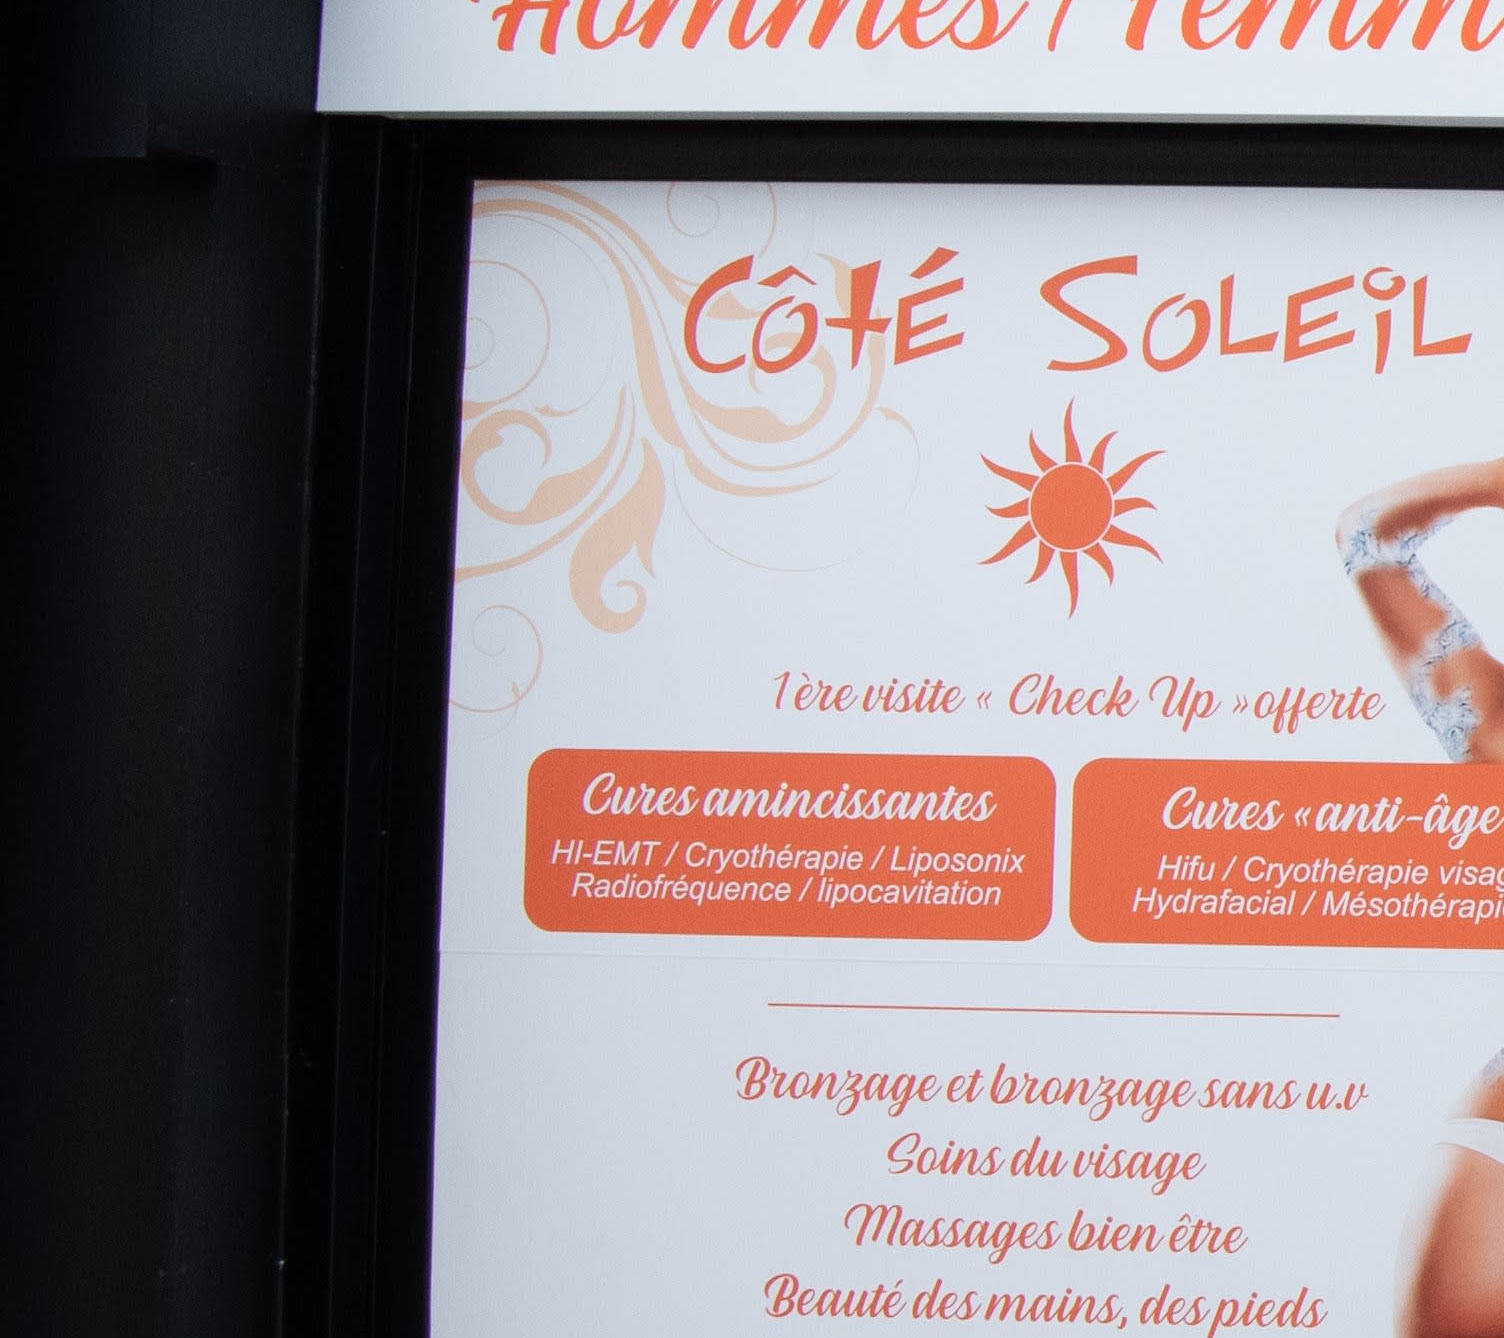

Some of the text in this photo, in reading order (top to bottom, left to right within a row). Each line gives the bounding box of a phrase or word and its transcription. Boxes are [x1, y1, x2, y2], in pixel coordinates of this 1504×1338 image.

[774, 670, 851, 712] 1ère
[860, 677, 959, 714] visite
[1008, 673, 1132, 718] Check
[1147, 675, 1215, 732] Up
[583, 773, 996, 821] Cures amincissantes
[1163, 787, 1283, 830] Cures
[552, 841, 1024, 876] HI-EMT Cryothérapie Liposonix
[1158, 856, 1214, 880] Hifu
[1244, 857, 1428, 889] Cryothérapie
[573, 873, 1000, 908] Radiofréquence lipocavitation
[1133, 888, 1295, 919] Hydrafacial
[734, 1056, 1366, 1124] Bronzage et bronzage sans u.v
[886, 1132, 1200, 1196] Soins du visage
[842, 1204, 1241, 1266] Massages bien être
[762, 1272, 901, 1319] Beauté
[911, 1278, 978, 1321] des
[983, 1288, 1127, 1330] mains,
[1138, 1284, 1206, 1327] des
